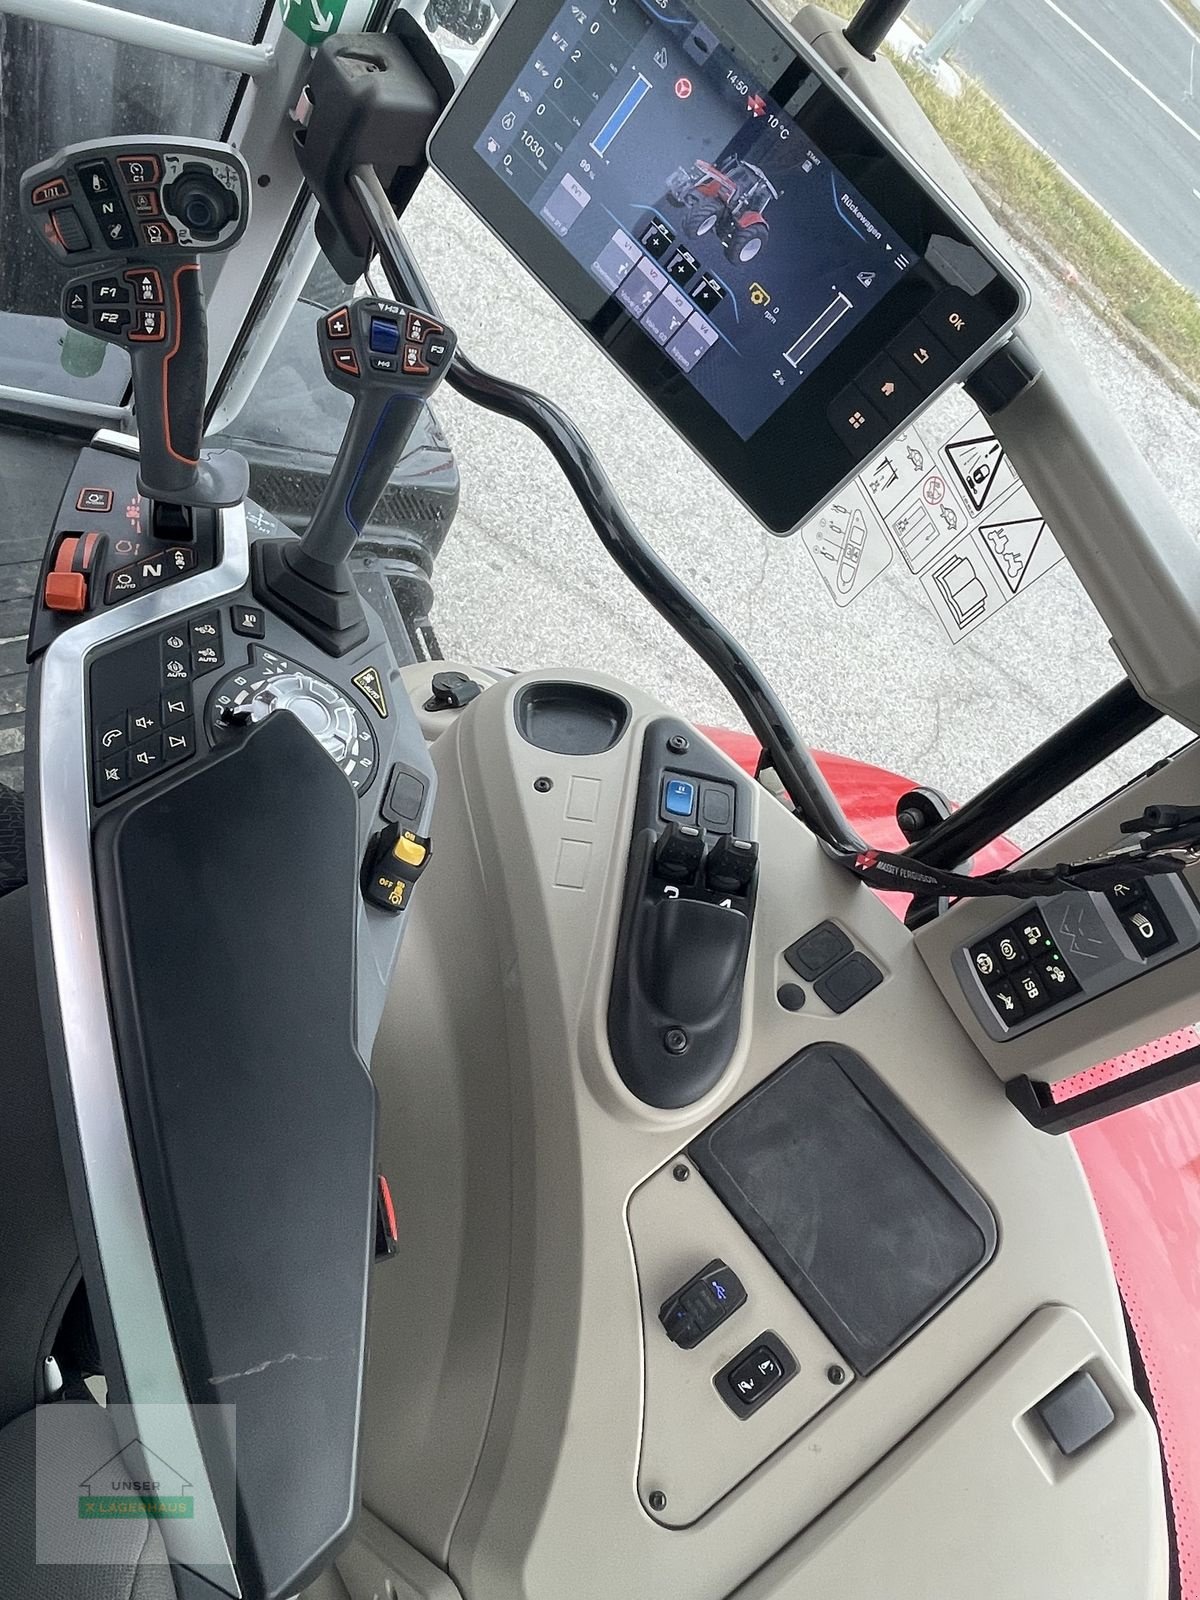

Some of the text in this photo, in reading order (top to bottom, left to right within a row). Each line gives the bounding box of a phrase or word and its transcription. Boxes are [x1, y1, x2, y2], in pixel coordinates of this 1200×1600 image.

[590, 21, 600, 34] 0
[571, 50, 581, 63] 2
[553, 77, 563, 89] 0
[726, 70, 749, 95] 14:50
[536, 103, 546, 116] 0
[767, 114, 790, 140] 10 °C
[520, 130, 545, 158] 1030
[503, 154, 512, 166] 0
[102, 203, 114, 214] N
[840, 193, 882, 240] Rückewagen
[624, 241, 633, 251] V1
[649, 269, 658, 280] V2
[100, 287, 117, 297] F1
[384, 304, 399, 314] H3
[100, 312, 120, 323] F2
[764, 310, 777, 325] rpm
[948, 312, 966, 331] OK
[430, 345, 445, 354] F3
[772, 369, 781, 380] 2
[142, 564, 162, 577] N
[364, 684, 380, 700] AUTO
[359, 731, 371, 741] 3
[359, 758, 372, 768] 2
[876, 860, 900, 876] MASSEY
[378, 877, 394, 888] OFF
[1021, 977, 1039, 999] ISB
